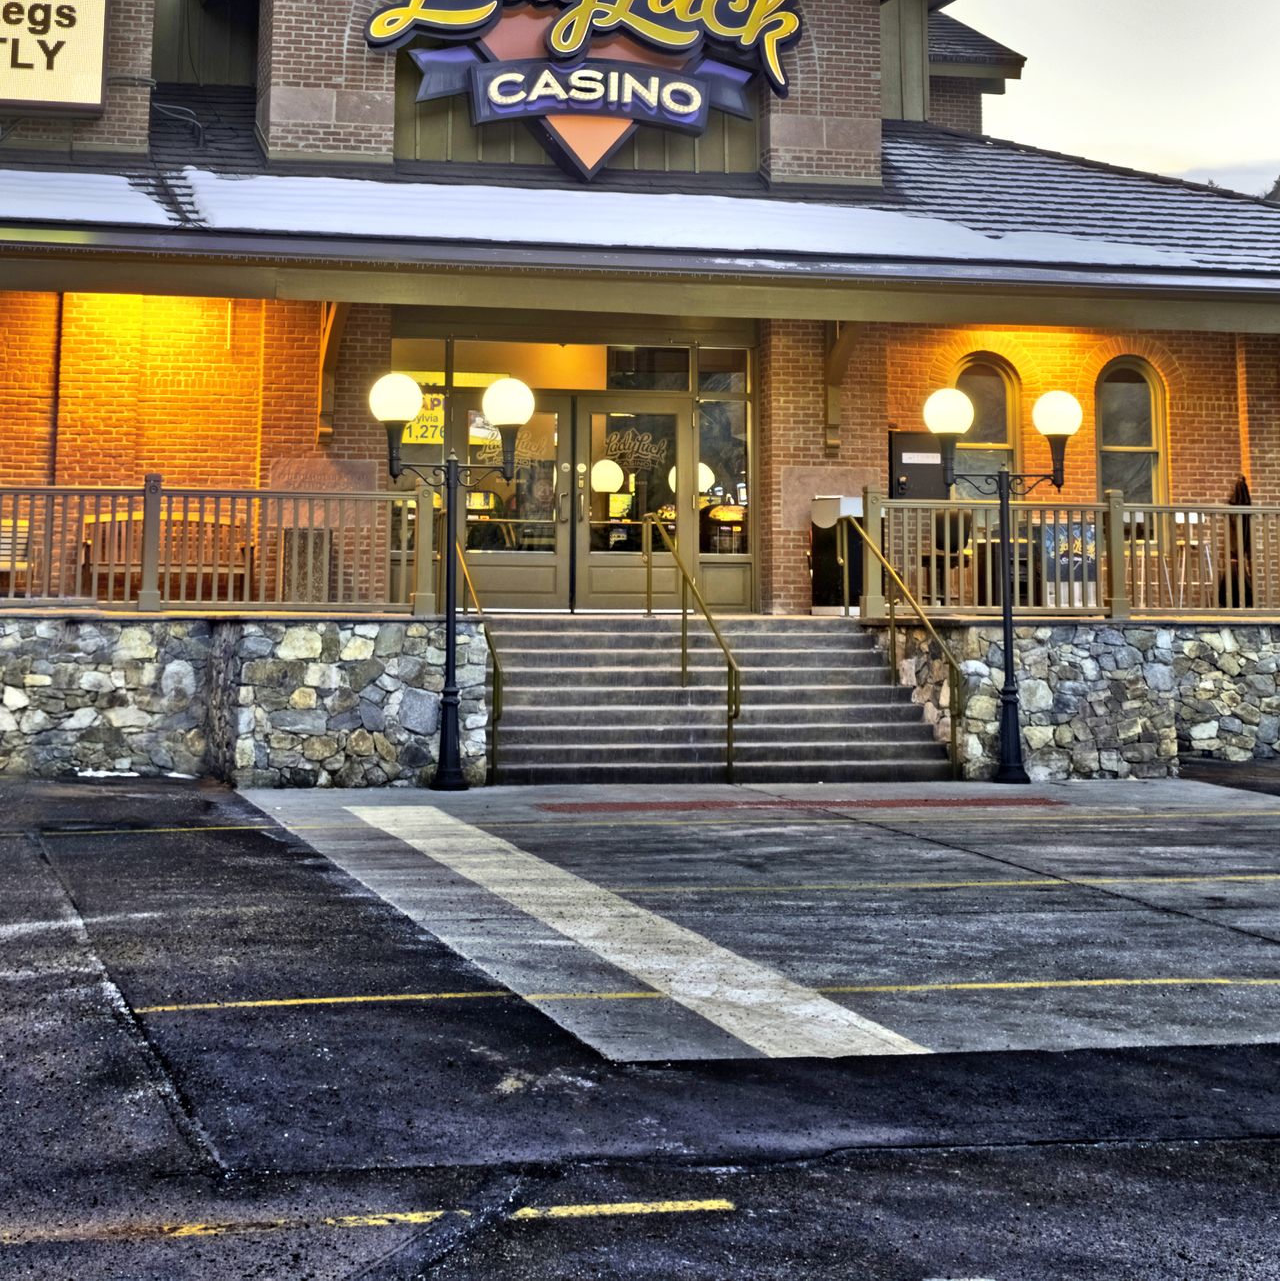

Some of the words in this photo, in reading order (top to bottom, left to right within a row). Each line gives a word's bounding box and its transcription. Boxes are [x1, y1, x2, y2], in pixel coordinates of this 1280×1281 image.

[487, 69, 702, 114] CASINO
[605, 432, 637, 460] Lady
[631, 432, 667, 464] Luck
